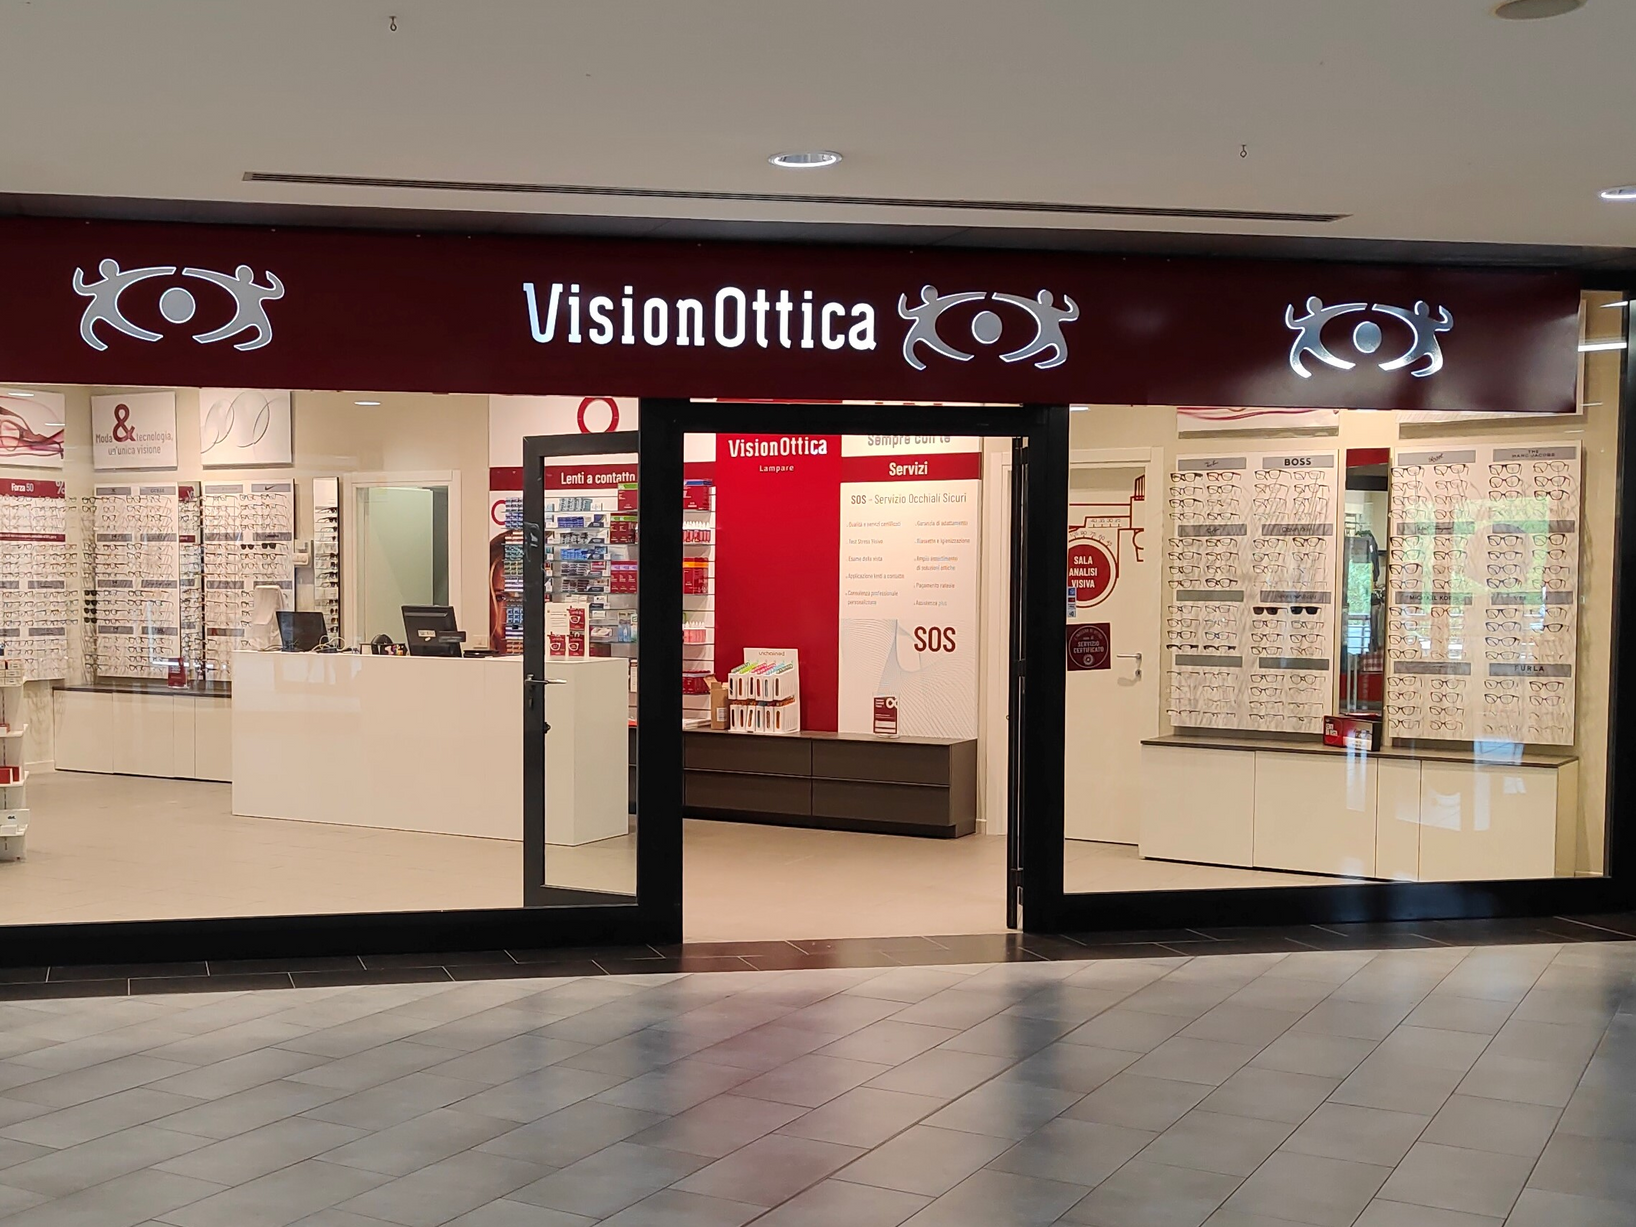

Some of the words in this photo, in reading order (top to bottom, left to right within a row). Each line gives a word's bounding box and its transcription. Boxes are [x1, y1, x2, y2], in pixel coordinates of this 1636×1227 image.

[523, 283, 877, 350] VisionOttica
[95, 433, 112, 443] Moda
[112, 403, 136, 442] &
[136, 431, 173, 443] tecnologia,
[728, 436, 827, 457] VisionOttica
[867, 435, 911, 448] Sempre
[108, 446, 135, 455] un'unica
[137, 445, 161, 454] visione
[1284, 457, 1312, 466] BOSS
[759, 465, 794, 473] Lampare
[889, 461, 928, 476] Servizi
[561, 472, 585, 484] Lenti
[587, 475, 593, 484] a
[595, 472, 636, 484] contatto
[851, 494, 867, 504] SOS
[874, 494, 906, 504] Servizio
[908, 493, 940, 503] Occhiali
[943, 492, 967, 503] Sicuri
[1073, 556, 1093, 565] SALA
[1069, 567, 1098, 577] ANALISI
[1071, 579, 1095, 588] VISIVA
[914, 626, 956, 652] SOS
